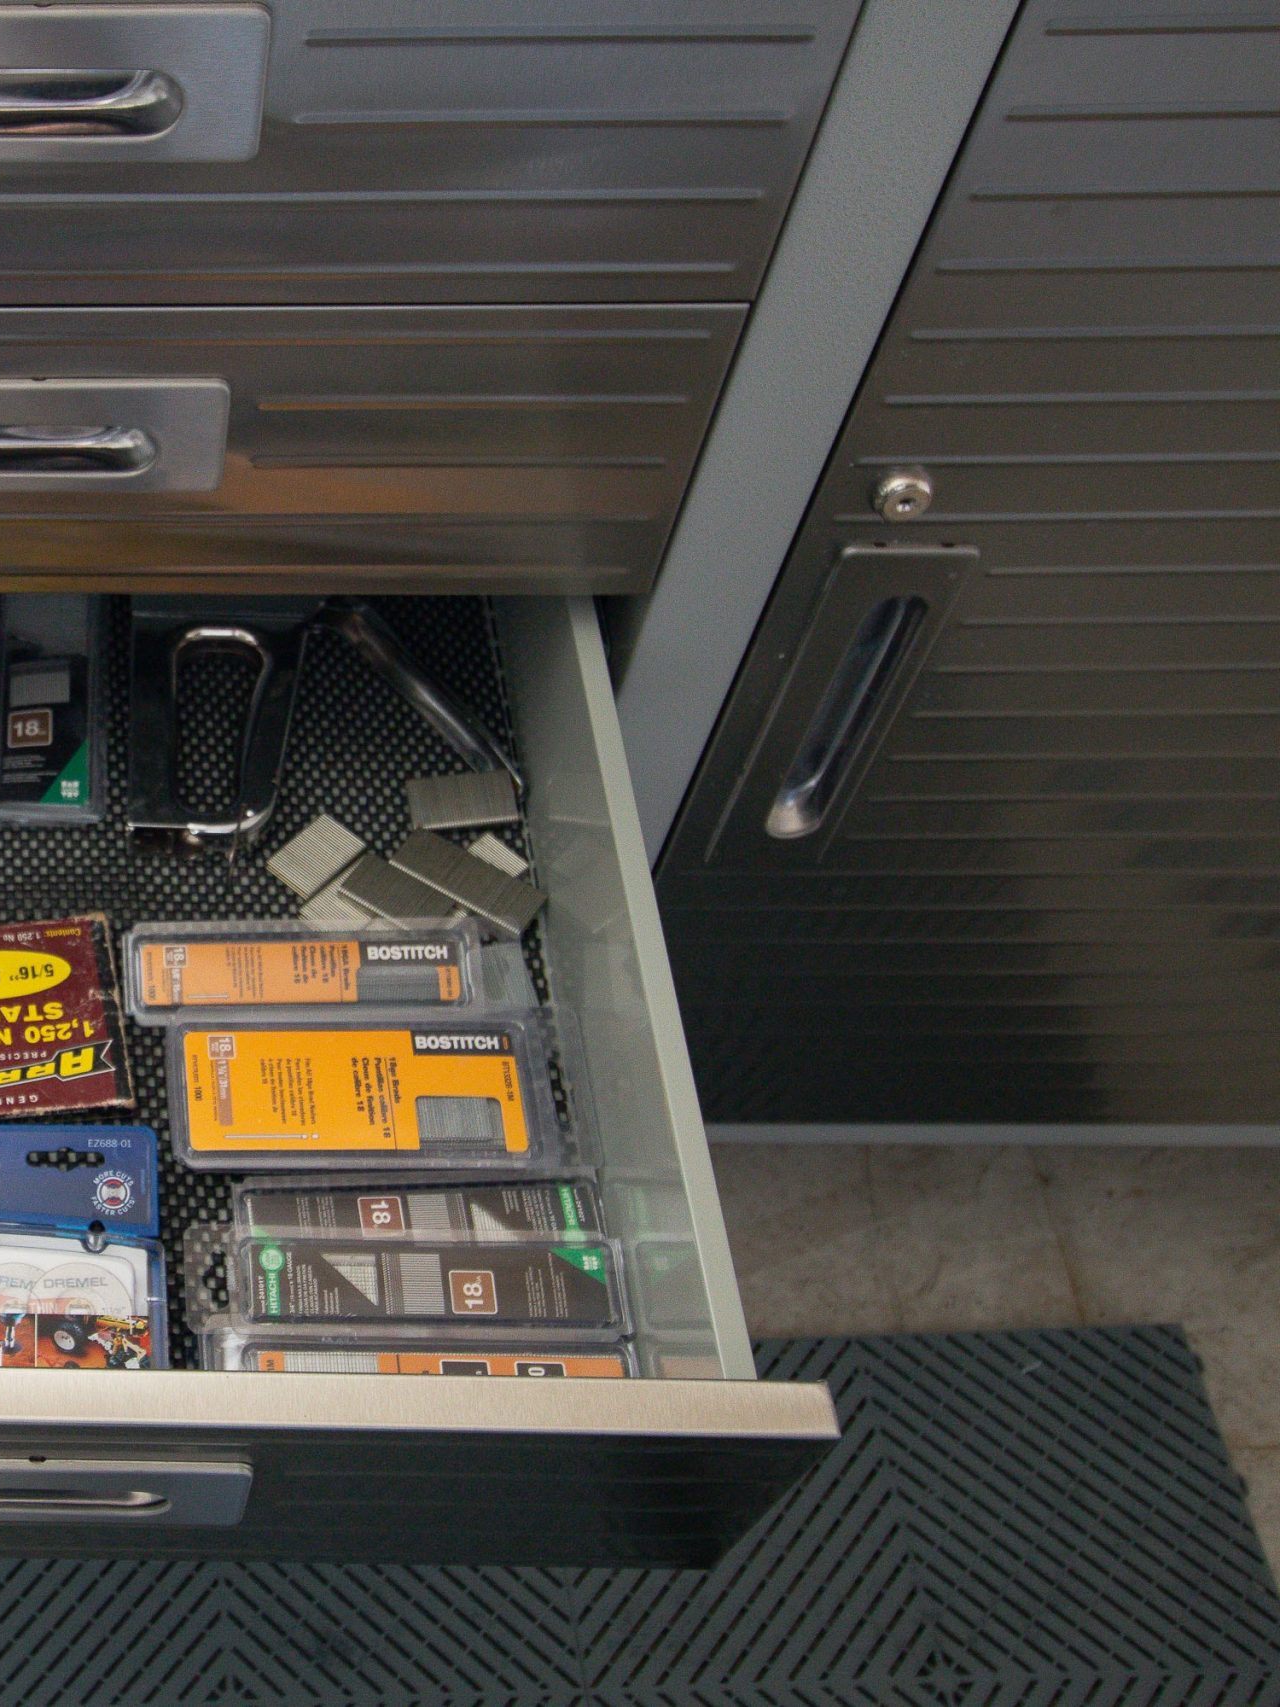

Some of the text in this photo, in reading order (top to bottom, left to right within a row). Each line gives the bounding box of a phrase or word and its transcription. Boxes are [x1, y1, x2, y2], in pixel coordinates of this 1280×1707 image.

[14, 720, 39, 736] 18
[366, 946, 448, 961] BOSTITCH
[25, 1021, 95, 1044] 1,250
[219, 1038, 232, 1052] 18
[414, 1036, 500, 1050] BOSTITCH
[352, 1057, 360, 1068] de
[356, 1100, 365, 1112] 18
[366, 1083, 373, 1094] de
[382, 1126, 392, 1138] 18
[88, 1138, 132, 1148] EZ688-01
[93, 1170, 134, 1186] MORE CUTS
[91, 1196, 116, 1216] FASTER
[370, 1200, 390, 1226] 18
[561, 1188, 574, 1226] HITACHI
[44, 1276, 108, 1288] DREMEL
[268, 1272, 278, 1314] HITACHI
[463, 1283, 484, 1309] 18
